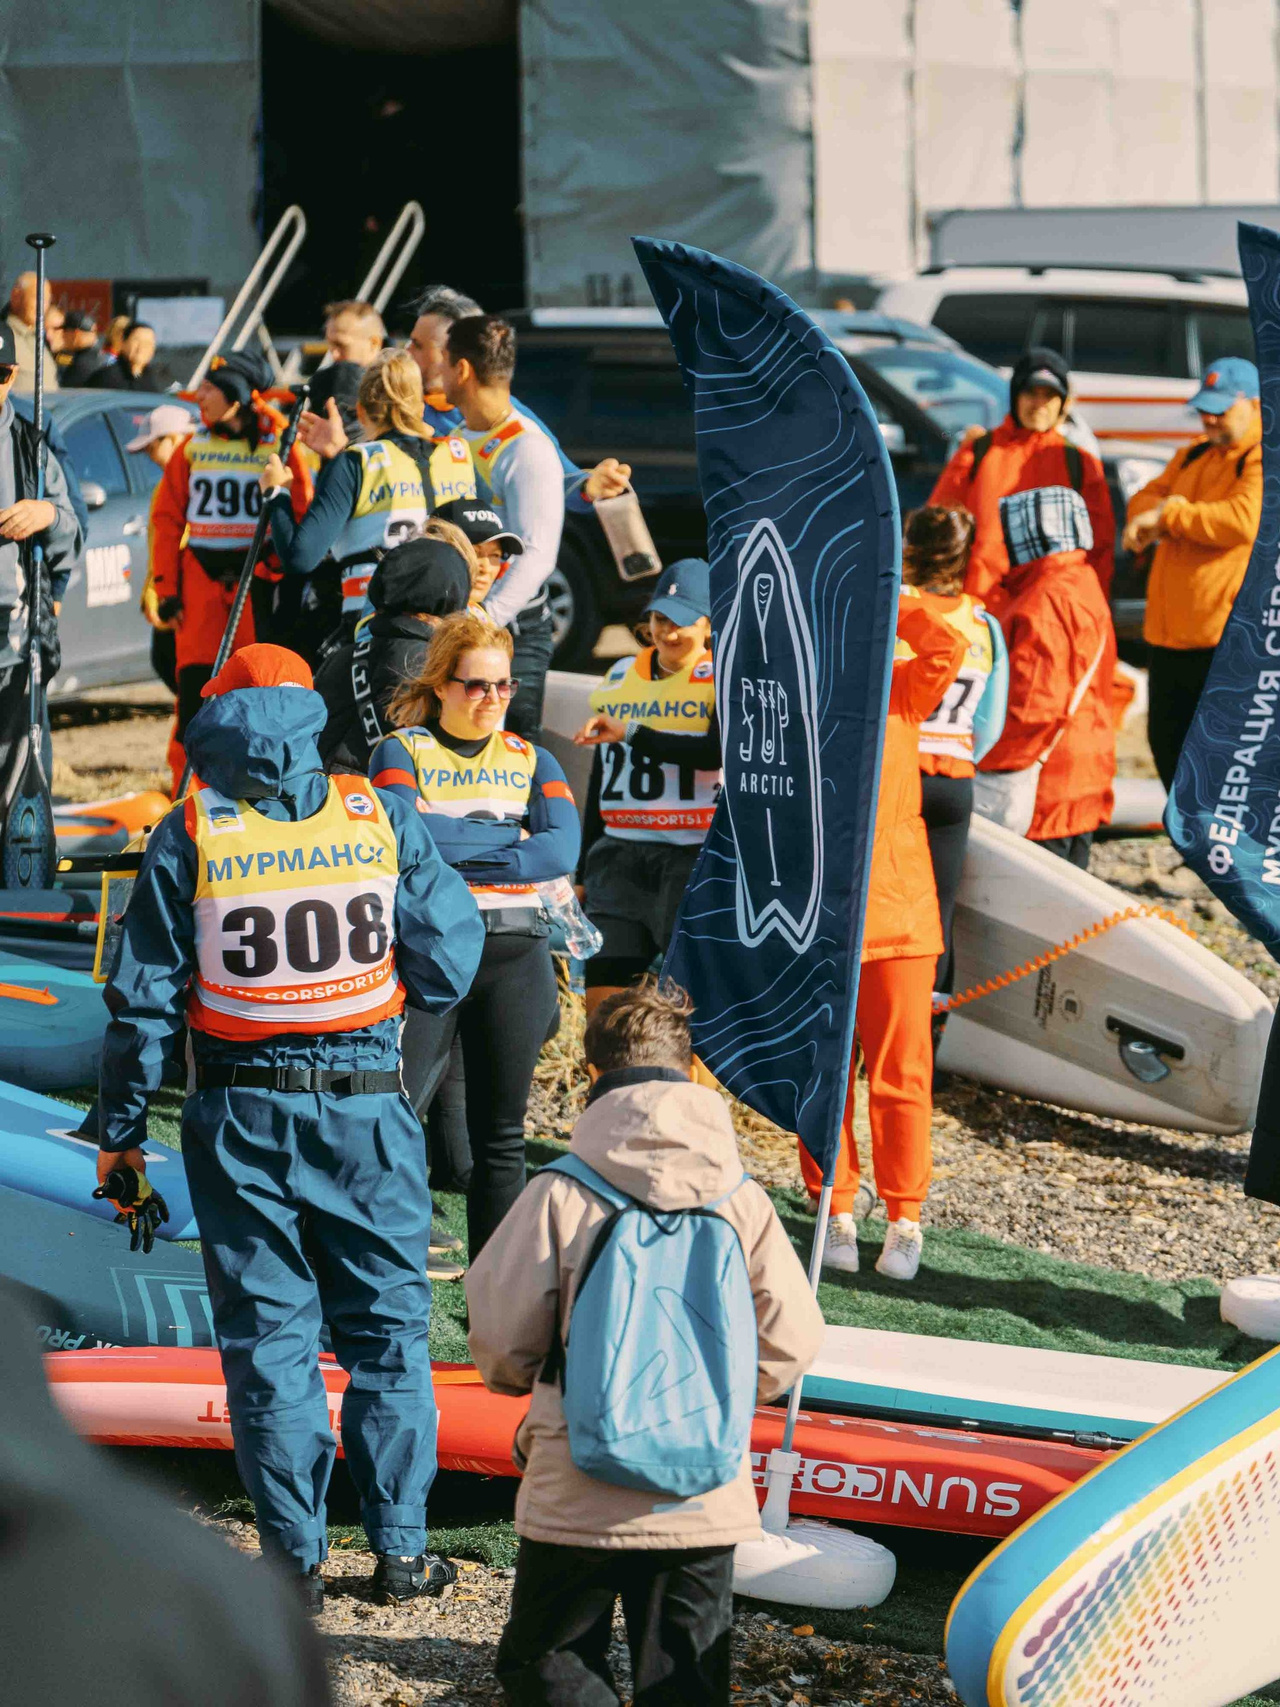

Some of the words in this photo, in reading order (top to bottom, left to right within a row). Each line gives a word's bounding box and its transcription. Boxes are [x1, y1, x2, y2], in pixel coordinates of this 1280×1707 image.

[599, 700, 712, 719] УРМАНСК
[740, 772, 794, 797] ARCTIC
[222, 893, 388, 978] 308
